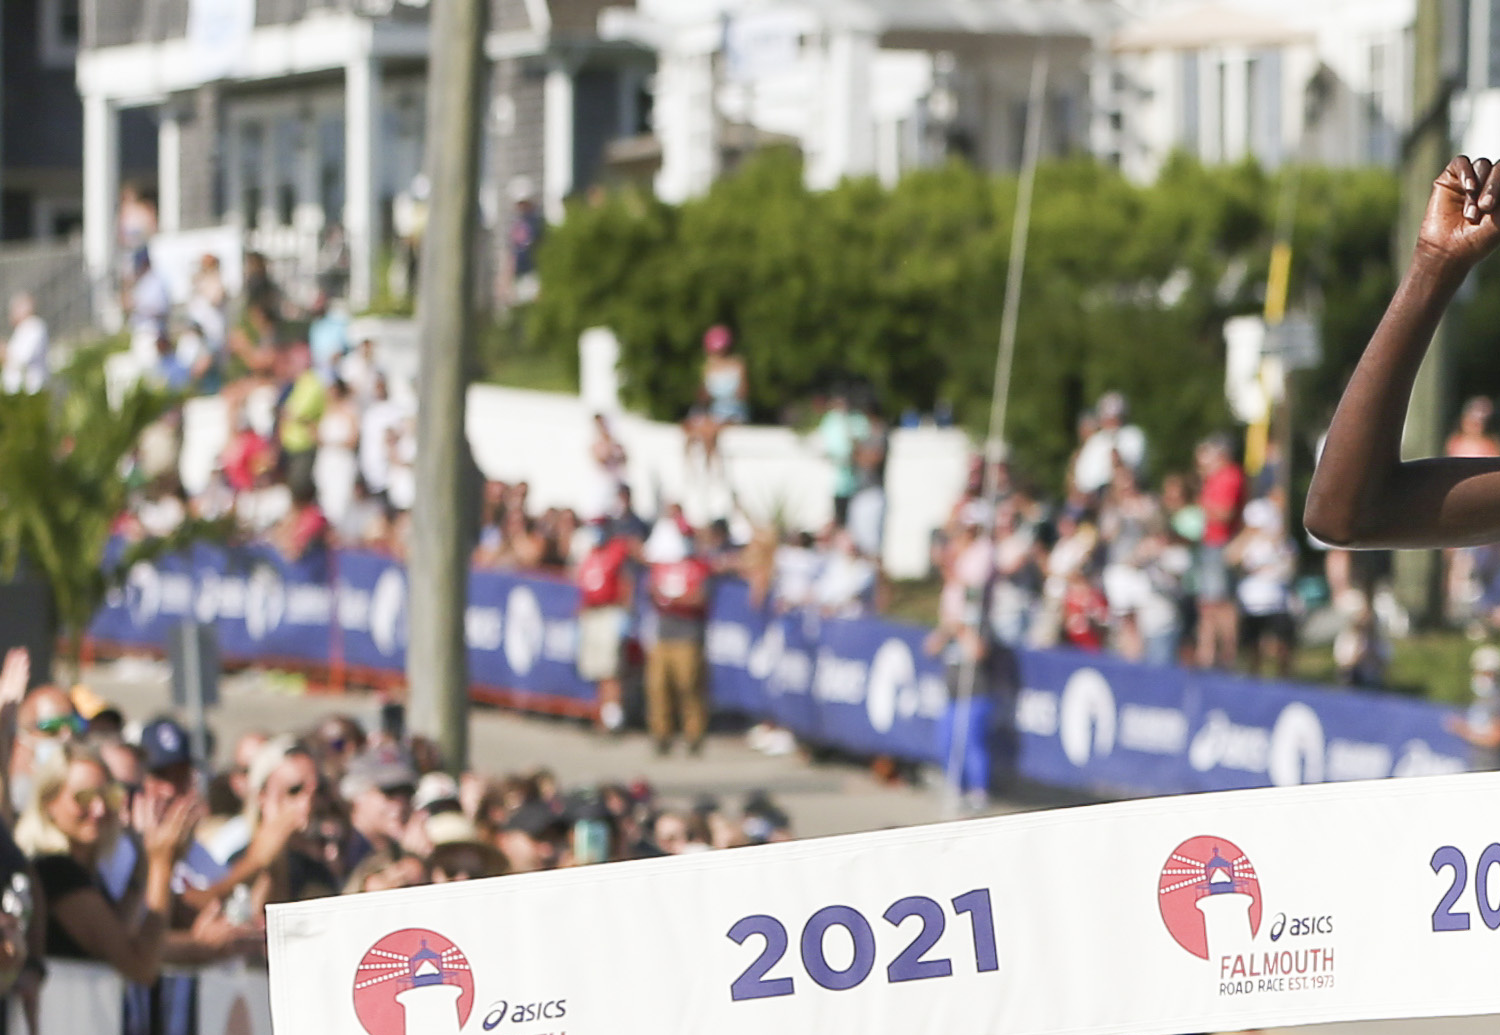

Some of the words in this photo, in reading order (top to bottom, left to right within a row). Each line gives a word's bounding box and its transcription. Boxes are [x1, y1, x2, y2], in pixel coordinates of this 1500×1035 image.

[726, 887, 999, 1002] 2021
[1220, 947, 1334, 979] FALMOUTH
[1219, 981, 1254, 996] ROAD
[1258, 978, 1285, 992] RACE
